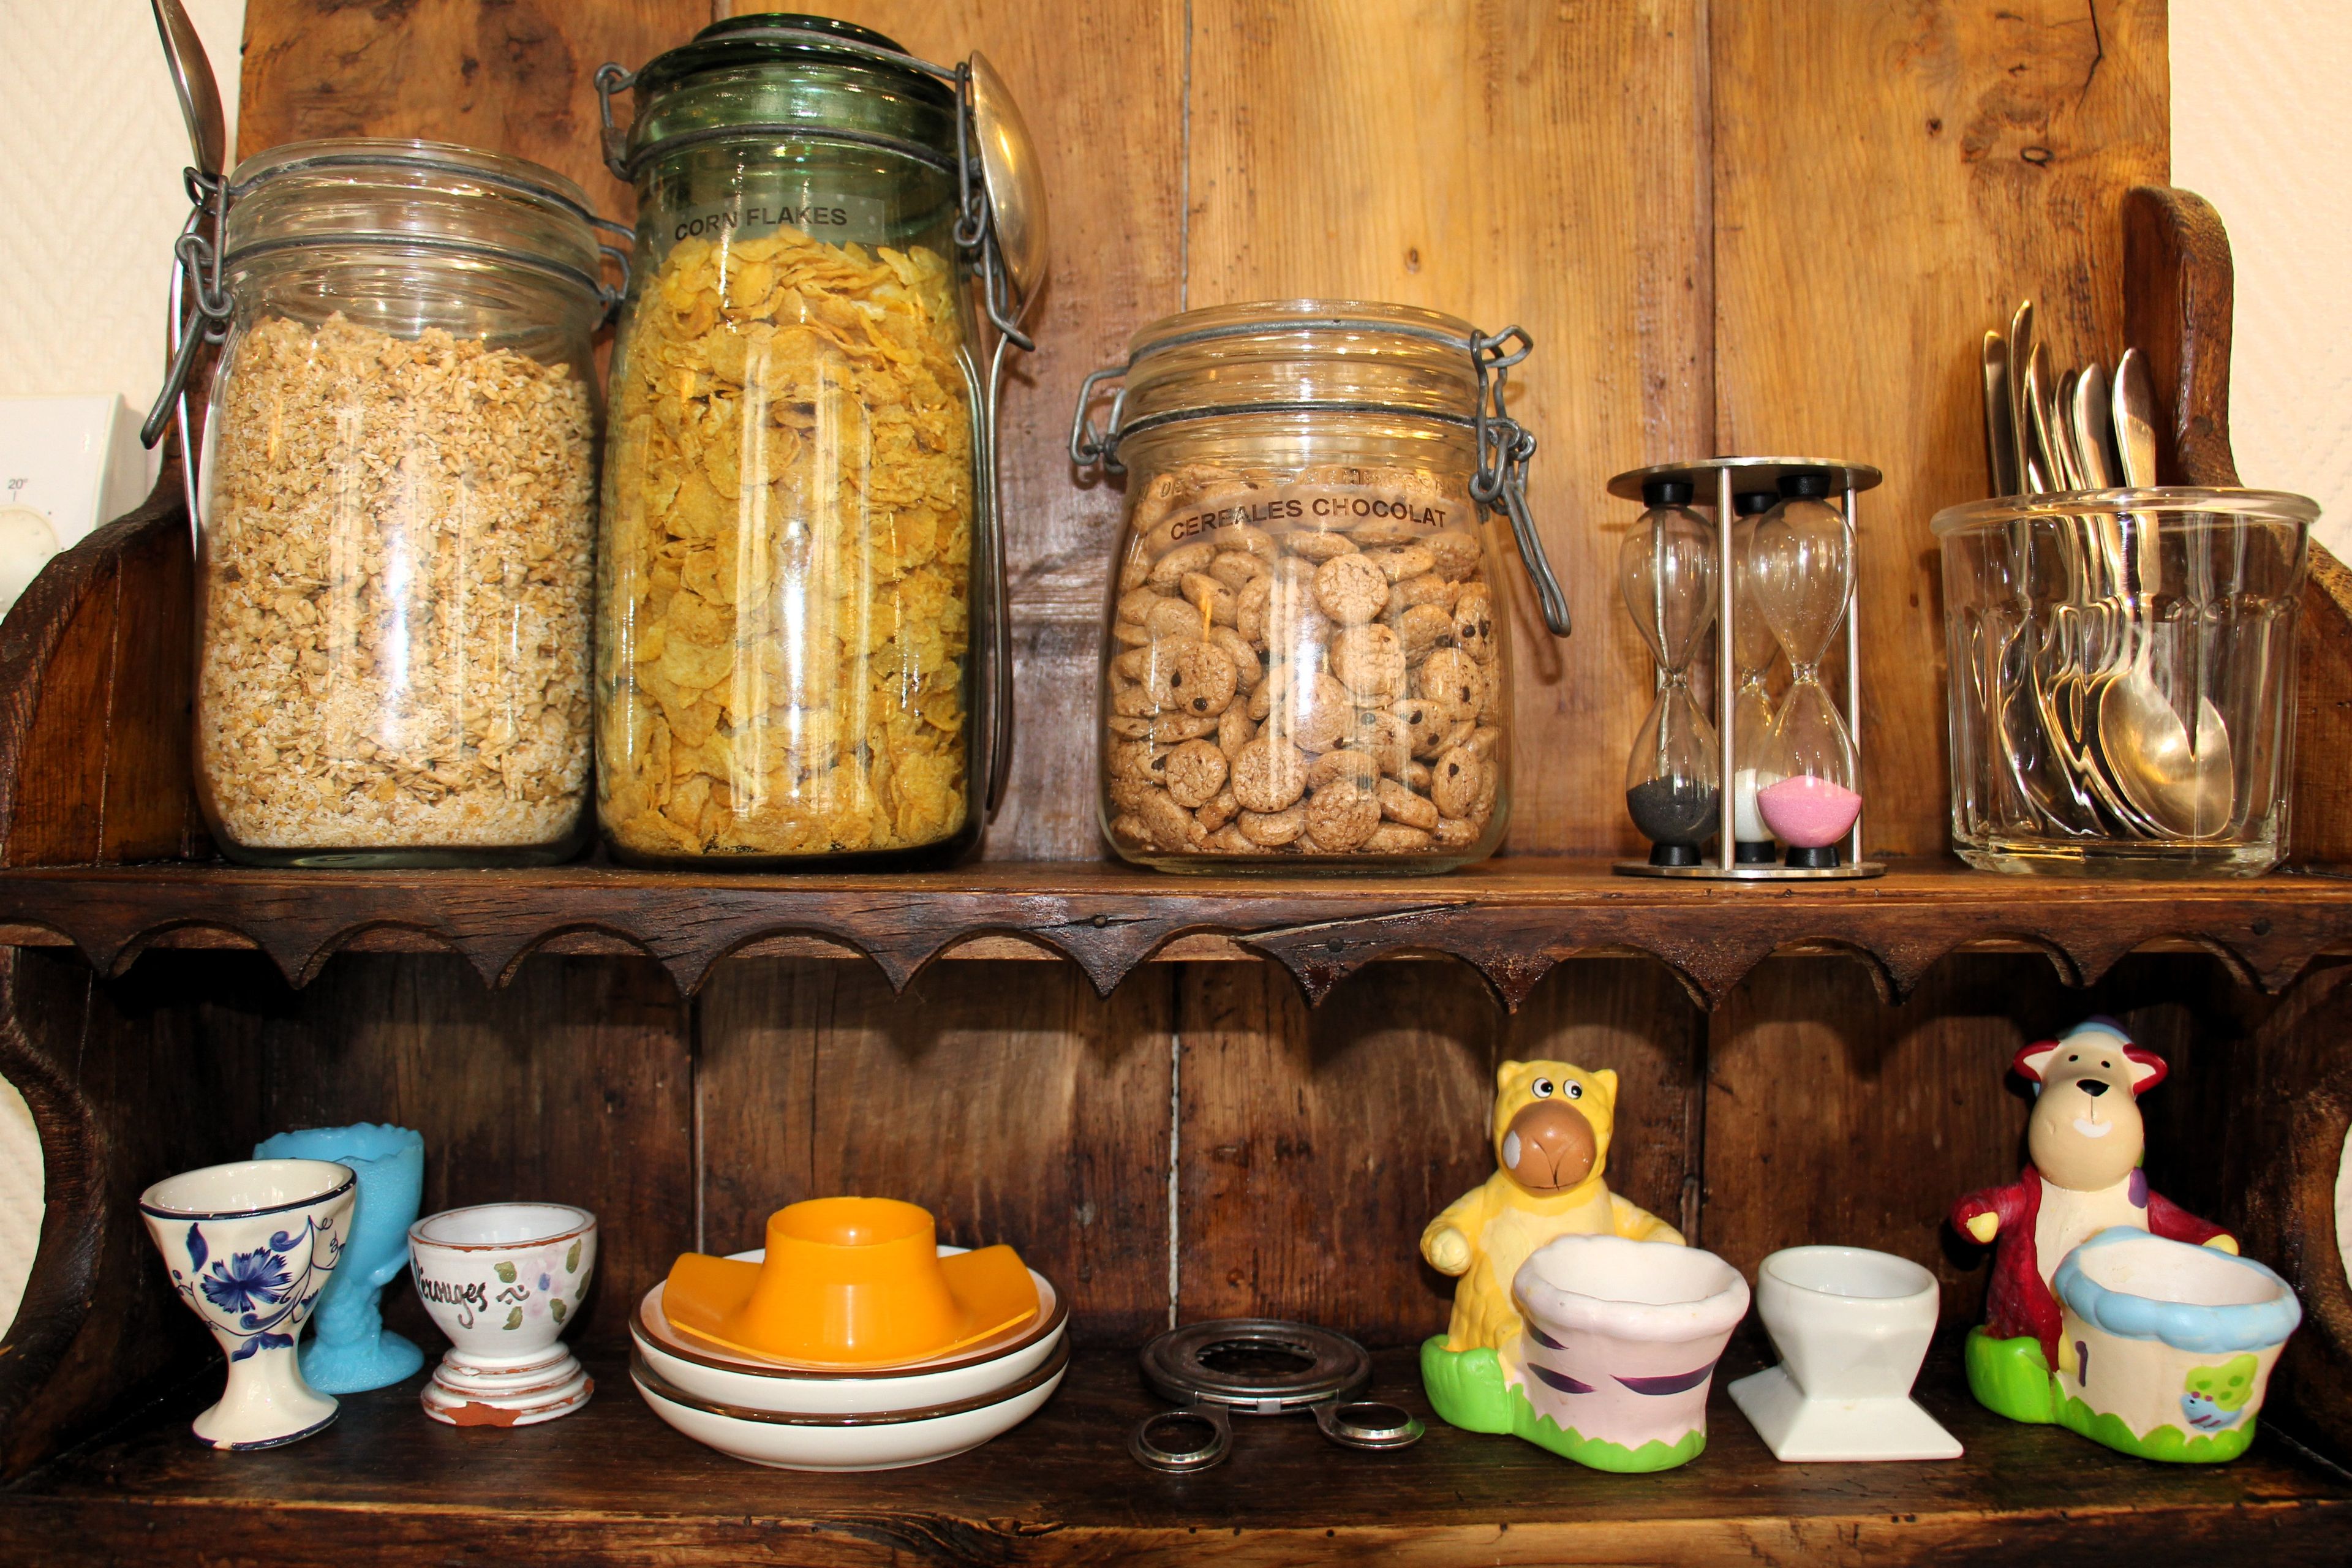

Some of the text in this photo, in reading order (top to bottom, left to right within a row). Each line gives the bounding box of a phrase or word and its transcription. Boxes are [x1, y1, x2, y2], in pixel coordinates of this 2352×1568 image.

[675, 207, 847, 241] CORN FLAKES
[1170, 498, 1446, 541] CEREALES CHOCOLAT
